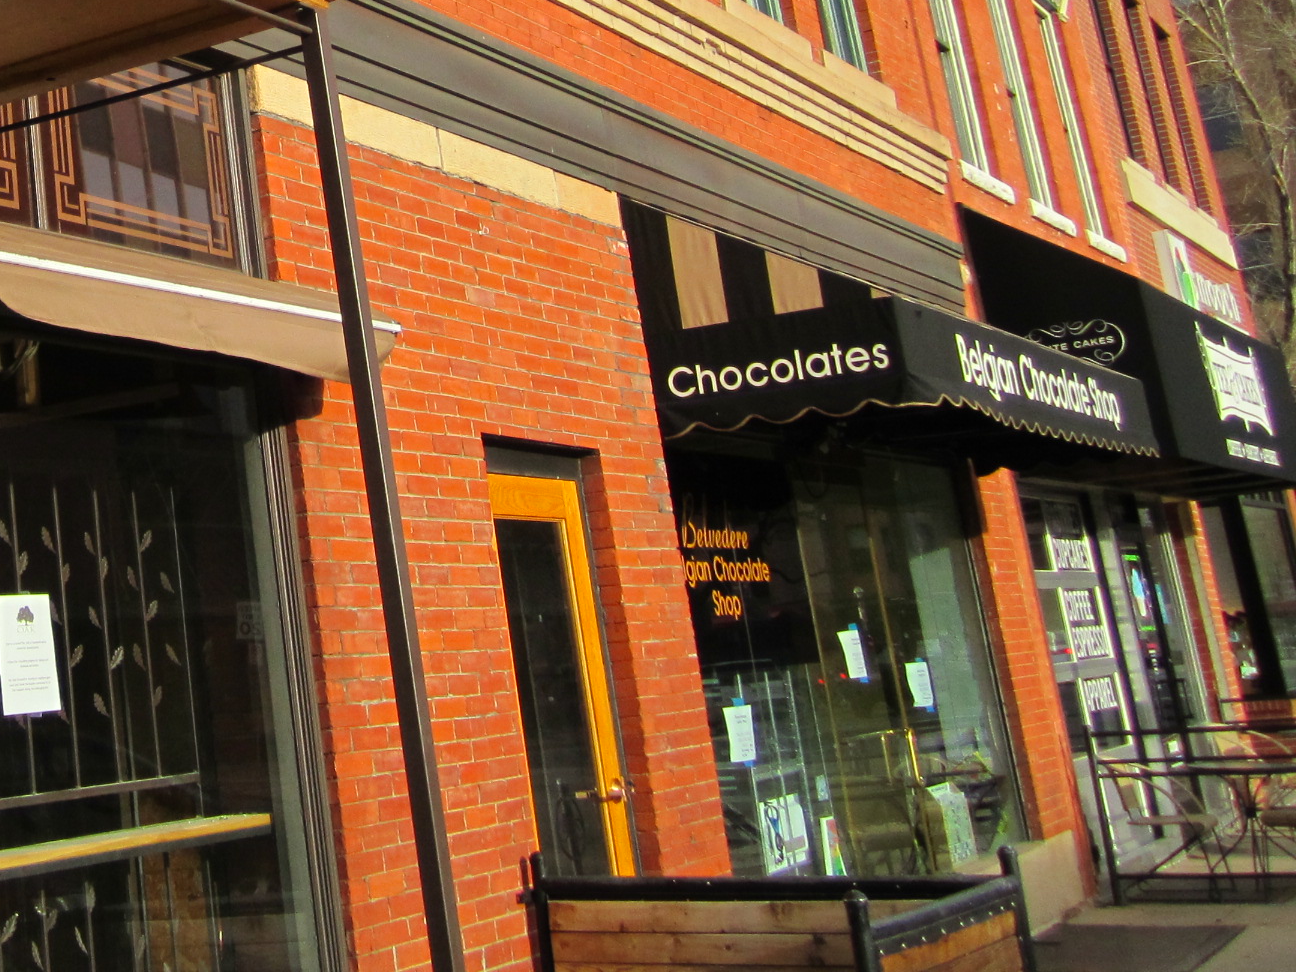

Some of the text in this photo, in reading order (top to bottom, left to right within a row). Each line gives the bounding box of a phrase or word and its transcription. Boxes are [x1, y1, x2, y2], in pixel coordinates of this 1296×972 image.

[1072, 335, 1115, 349] CAKES
[667, 343, 890, 399] Chocolates
[954, 333, 1121, 432] Belgian Chocolate Shop
[681, 498, 749, 550] Belvedere
[681, 555, 771, 588] lgian Chocolate
[711, 589, 742, 621] Shop
[1064, 590, 1095, 622] COFFEE
[1072, 625, 1110, 658] ESPRESSO
[1083, 676, 1118, 712] APPAREL
